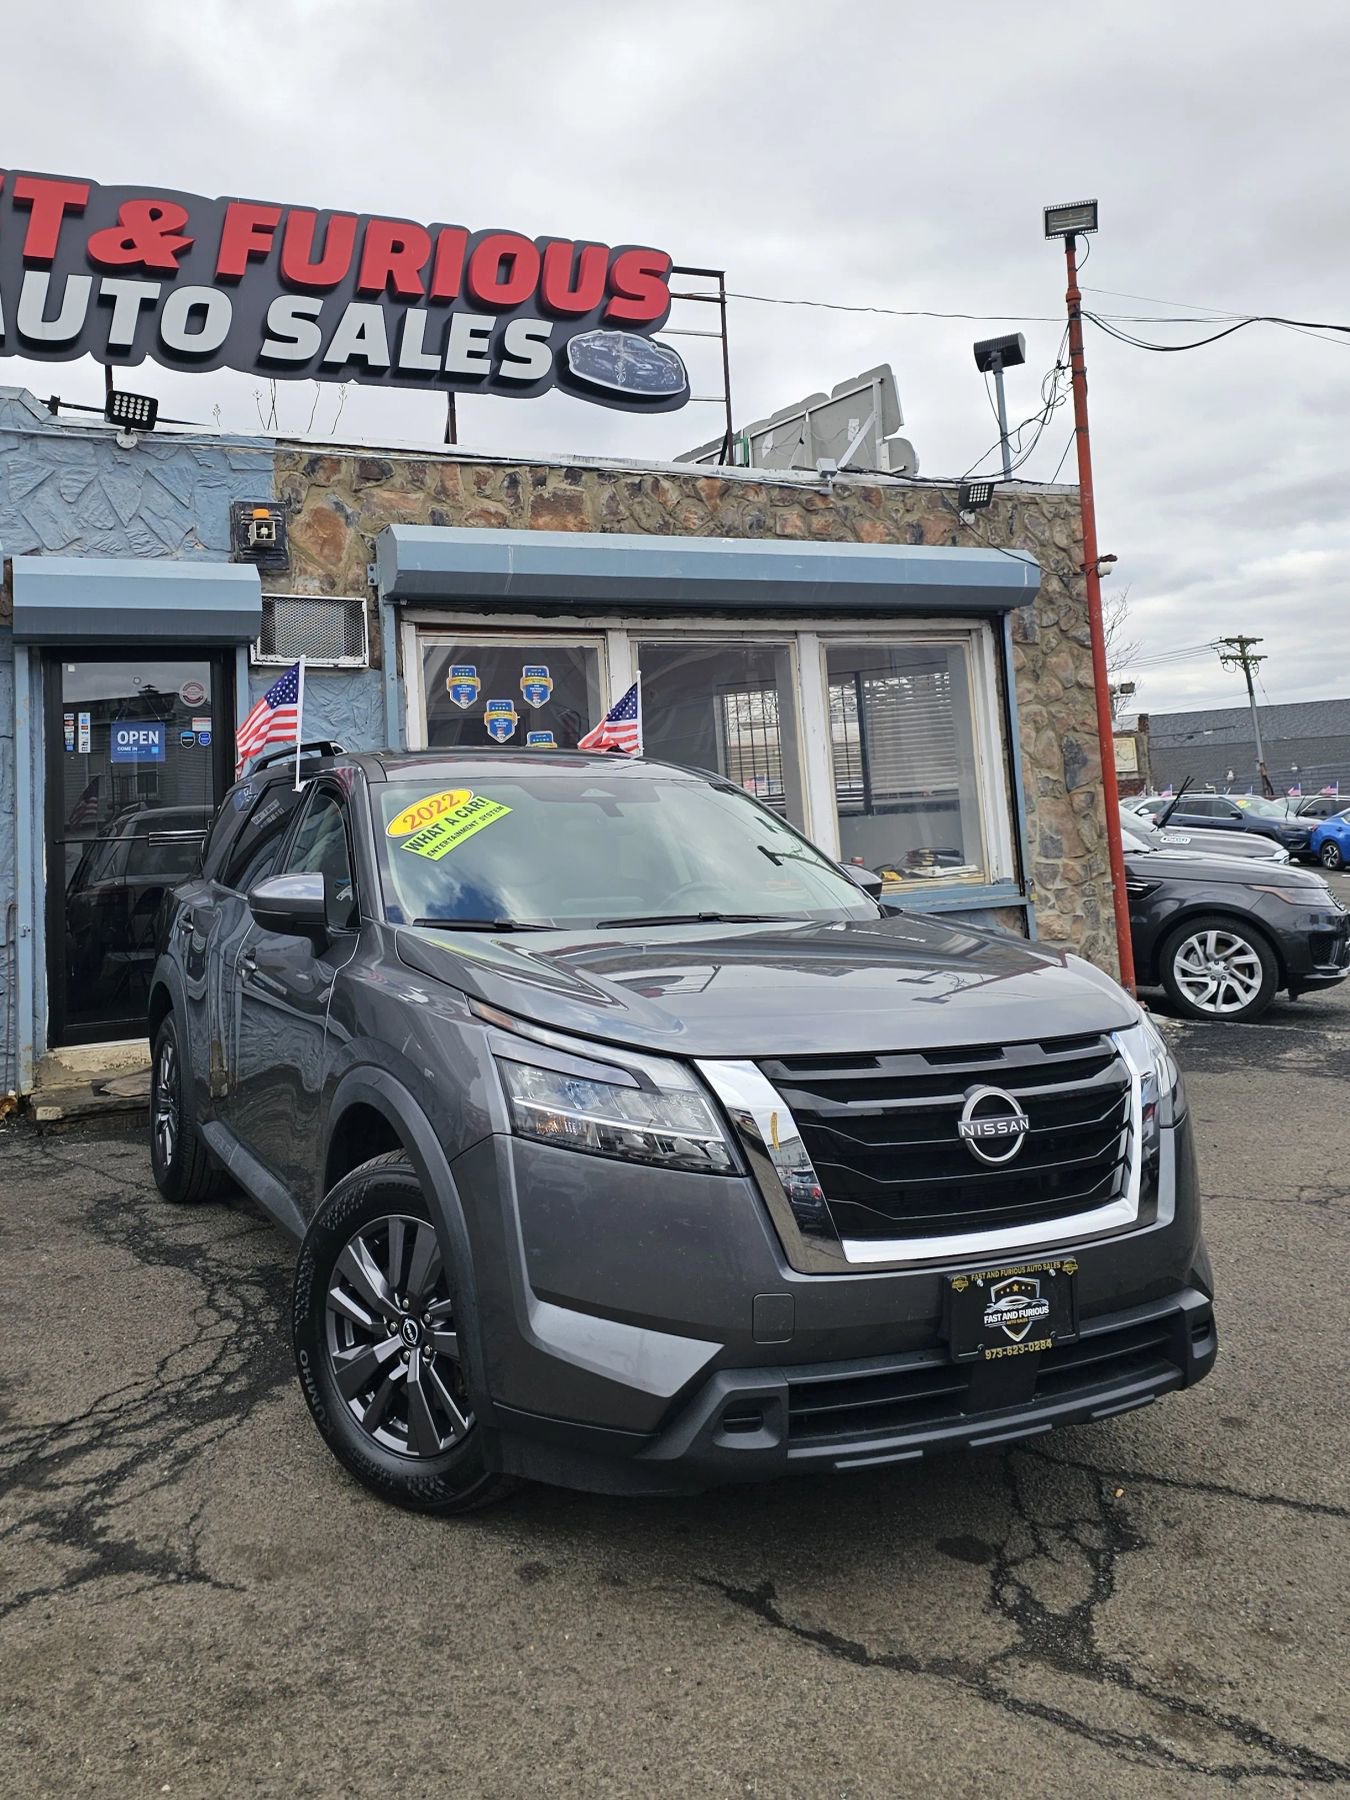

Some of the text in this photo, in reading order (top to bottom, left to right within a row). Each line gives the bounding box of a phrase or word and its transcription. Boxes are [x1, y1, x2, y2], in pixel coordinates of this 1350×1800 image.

[0, 175, 673, 322] T & FURIOUS
[260, 296, 554, 380] SALES
[117, 730, 159, 745] OPEN
[402, 793, 461, 831] 2022
[405, 798, 490, 851] WHAT A CAR!
[426, 805, 506, 858] ENTERTAINMENT SYSTEM
[961, 1118, 1029, 1136] NISSAN
[971, 1273, 986, 1281] FAST
[986, 1271, 1000, 1279] AND
[1000, 1267, 1026, 1278] FURIOUS
[1026, 1264, 1043, 1273] AUTO
[1042, 1261, 1061, 1270] SALES
[984, 1305, 1050, 1324] FAST AND FURIOUS
[985, 1339, 1052, 1359] 973-623-0284
